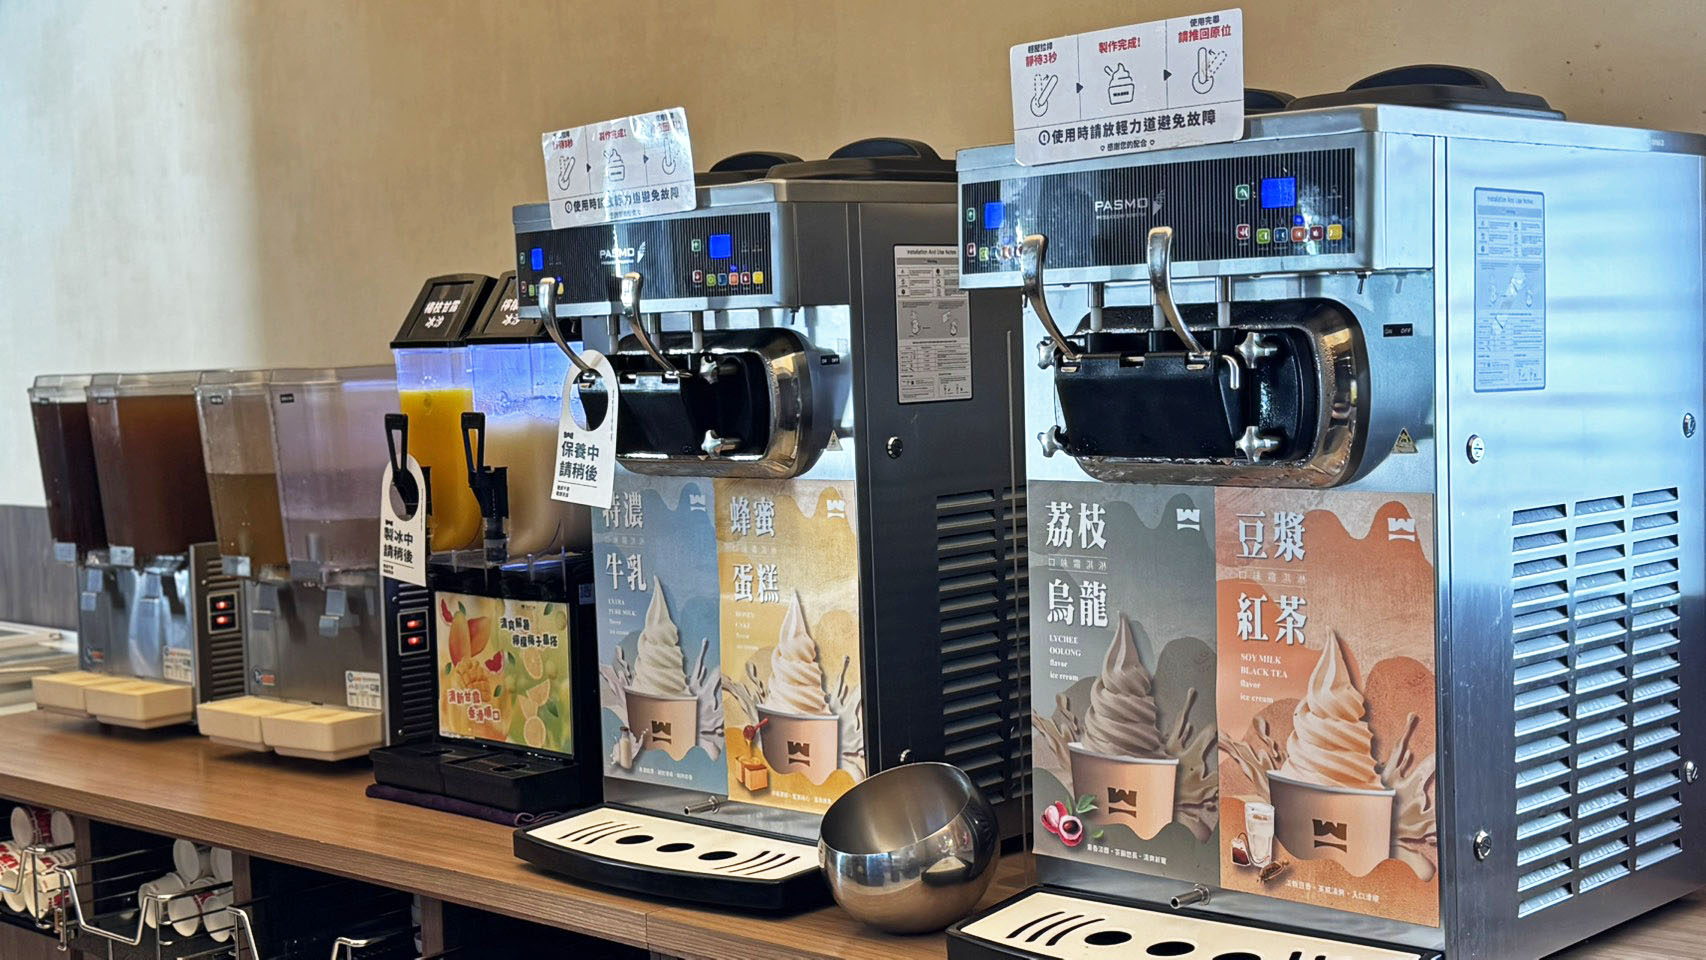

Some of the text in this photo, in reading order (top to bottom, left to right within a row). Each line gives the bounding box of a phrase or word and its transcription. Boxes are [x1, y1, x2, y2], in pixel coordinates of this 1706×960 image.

[1190, 15, 1220, 28] 使用完畢
[1178, 24, 1232, 44] 請推回原位
[1098, 36, 1141, 53] 製作完成!
[1051, 109, 1217, 143] 使用時請放輕力道避免故障
[1107, 139, 1147, 152] 感謝您的配合
[1095, 198, 1148, 212] PASMO
[561, 441, 599, 461] 保養中
[559, 461, 598, 482] 請稍後
[730, 495, 775, 538] 蜂蜜
[1045, 501, 1107, 550] 荔枝
[384, 527, 413, 546] 製冰中
[1236, 510, 1306, 562] 豆漿
[384, 544, 413, 564] 請稍後
[606, 552, 647, 591] 牛乳
[733, 563, 779, 603] 蛋糕
[1047, 578, 1109, 628] 烏龍
[1237, 592, 1308, 645] 紅茶
[1049, 634, 1079, 645] LYCHEE
[1049, 647, 1081, 657] OOLONG
[1240, 652, 1282, 664] SOY MILK
[1050, 659, 1068, 668] flavor
[1240, 666, 1288, 679] BLACK TEA
[1240, 679, 1260, 688] flavor
[1240, 693, 1274, 704] ice cream
